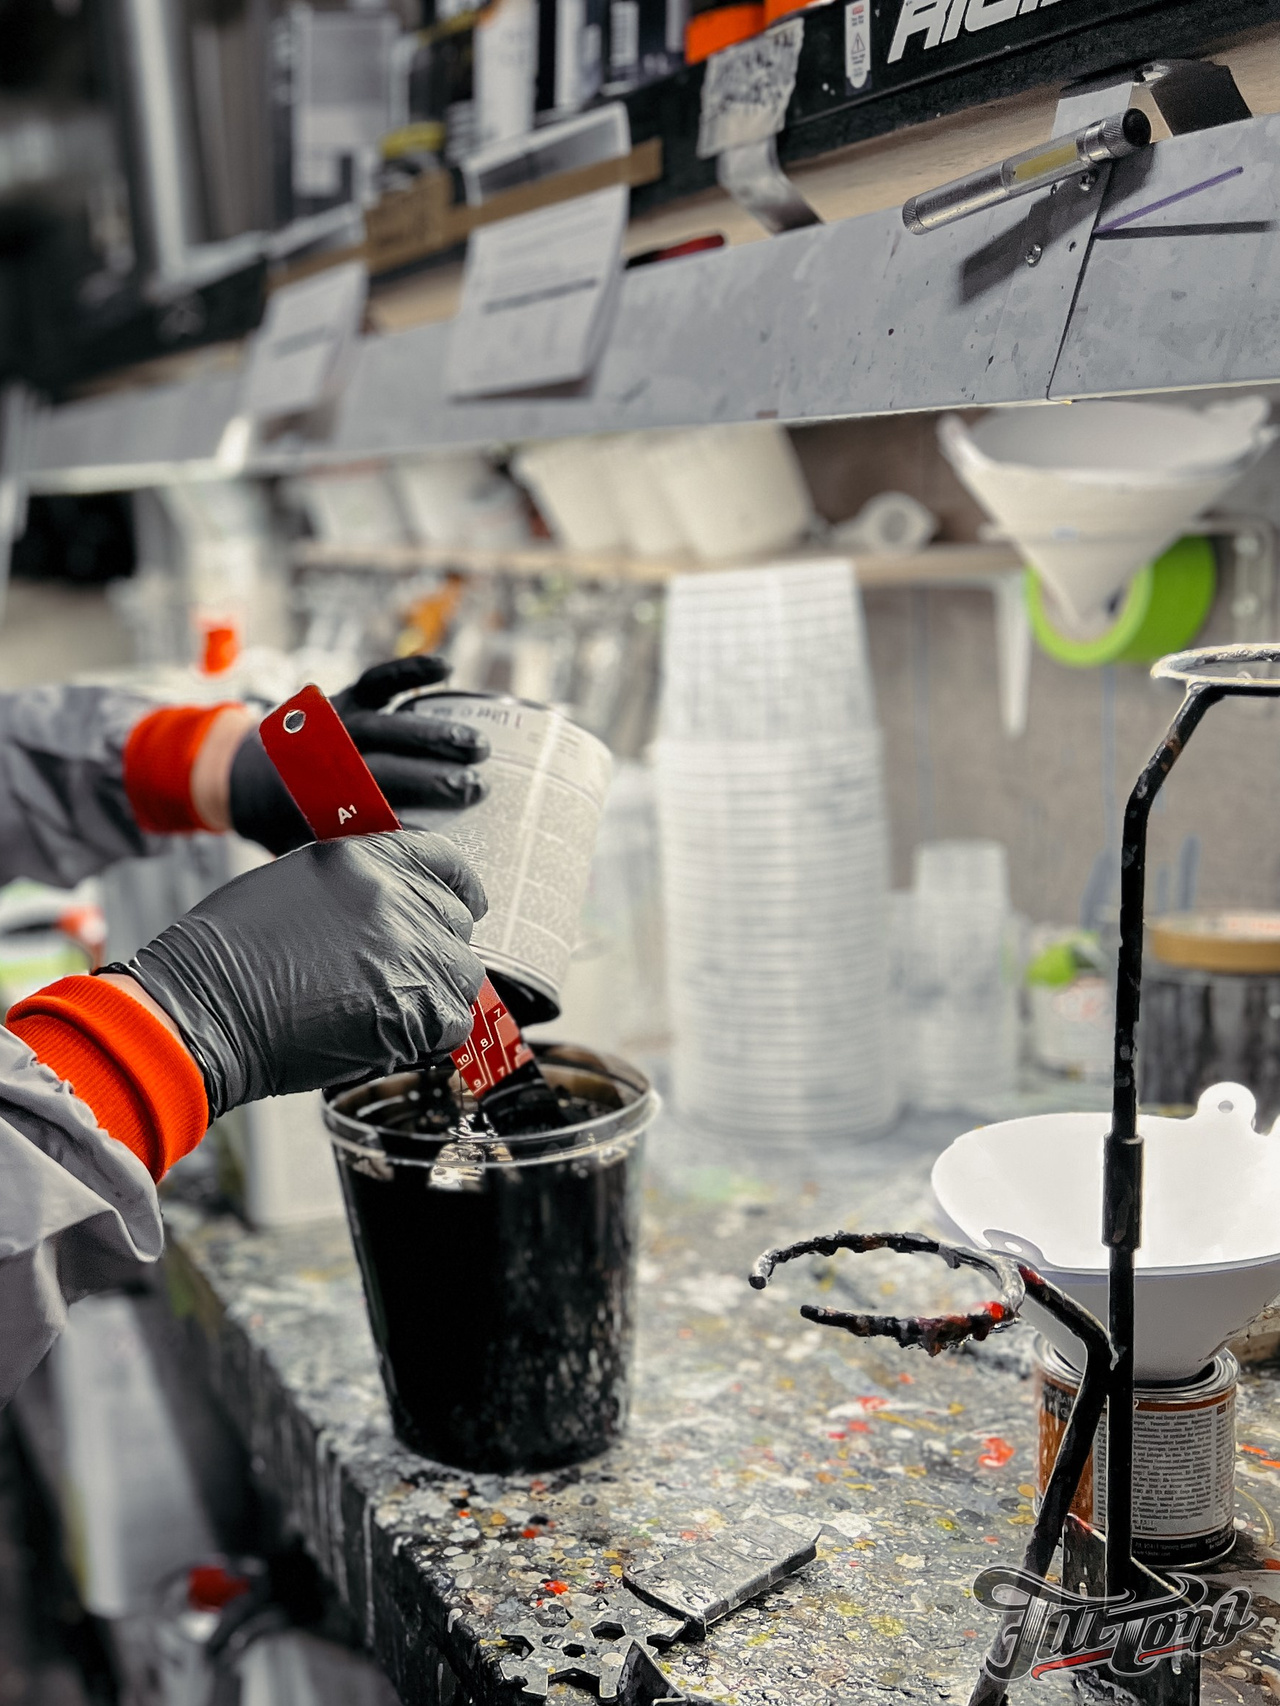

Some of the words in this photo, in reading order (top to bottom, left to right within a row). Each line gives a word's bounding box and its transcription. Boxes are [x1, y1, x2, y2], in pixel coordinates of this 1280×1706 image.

[493, 1007, 502, 1018] 7
[480, 1038, 489, 1048] 8
[456, 1053, 470, 1066] 10
[473, 1078, 482, 1089] 9
